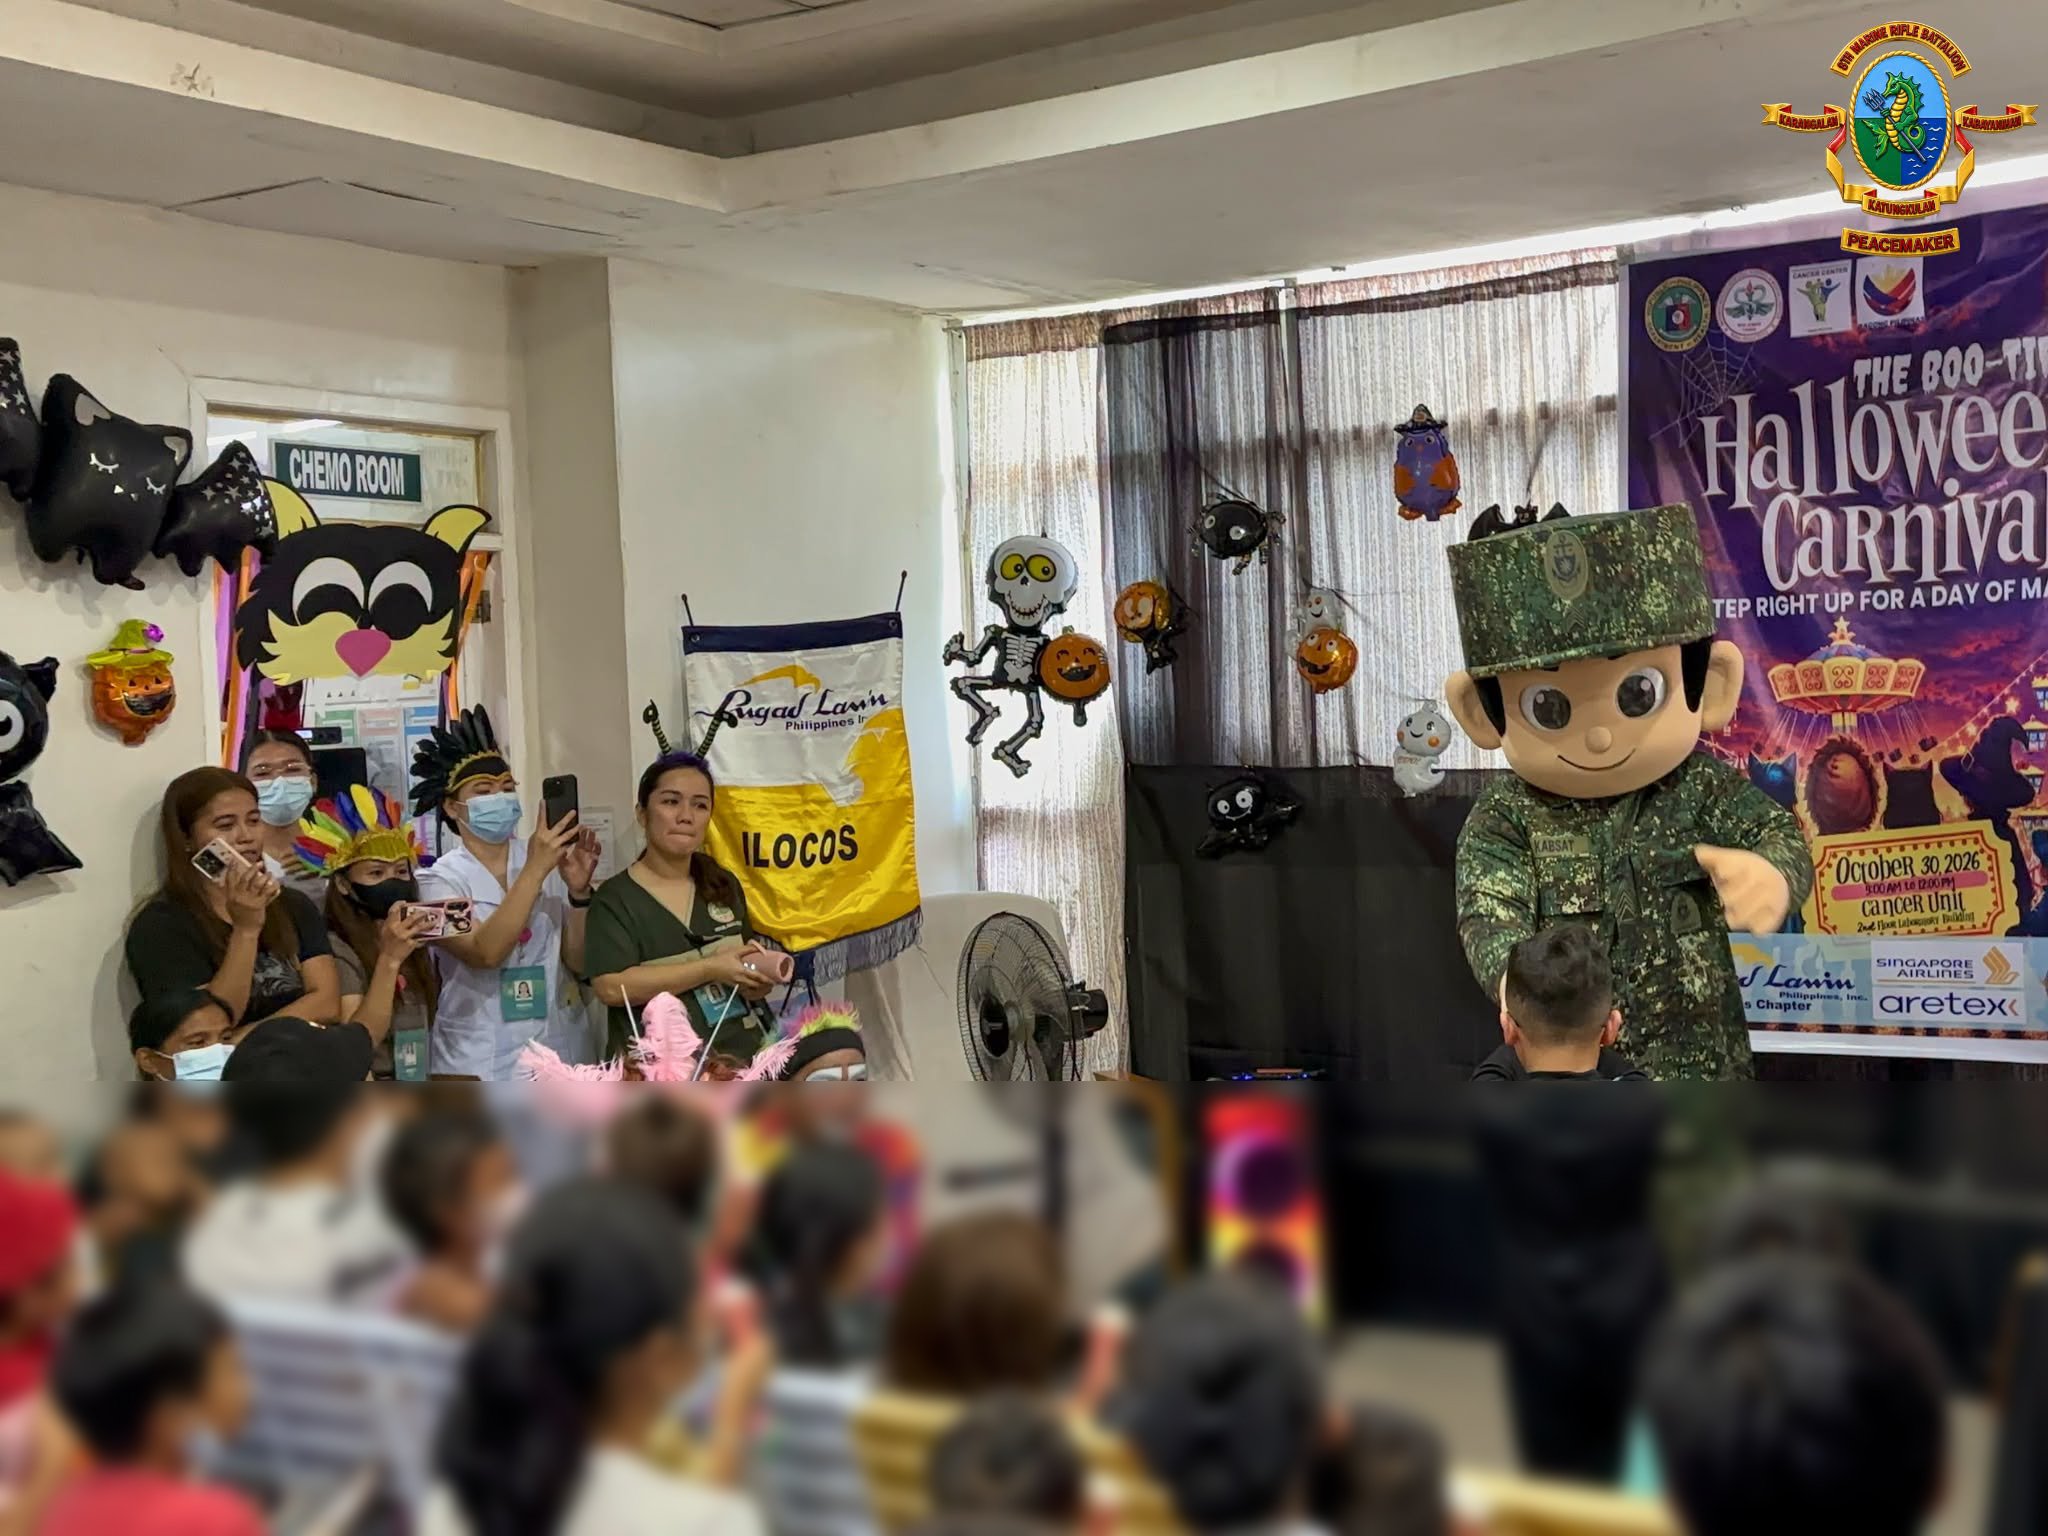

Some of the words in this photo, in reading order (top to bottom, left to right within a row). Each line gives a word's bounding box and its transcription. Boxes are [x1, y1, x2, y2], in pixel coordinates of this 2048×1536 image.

[1853, 354, 1911, 397] THE
[1699, 377, 2048, 510] Hallowee
[289, 447, 351, 492] CHEMO
[355, 453, 405, 496] ROOM
[1713, 598, 1751, 619] TEP
[1756, 594, 1819, 617] RIGHT
[1824, 591, 1855, 613] UP
[1859, 588, 1904, 612] FOR
[1910, 587, 1926, 608] A
[1931, 582, 1980, 607] DAY
[1985, 580, 2016, 602] OF
[2022, 577, 2048, 600] M
[813, 688, 889, 716] Lawin
[785, 715, 854, 732] Philippines
[742, 824, 859, 869] ILOCOS
[1533, 839, 1575, 853] KABSAT
[1945, 851, 1981, 873] 2026
[1928, 887, 1967, 913] Unit
[1876, 957, 1974, 969] SINGAPORE
[1896, 968, 1975, 980] AIRLINES
[1756, 999, 1812, 1013] Chapter
[1847, 993, 1868, 1001] Inc.
[1879, 991, 2008, 1017] aretex
